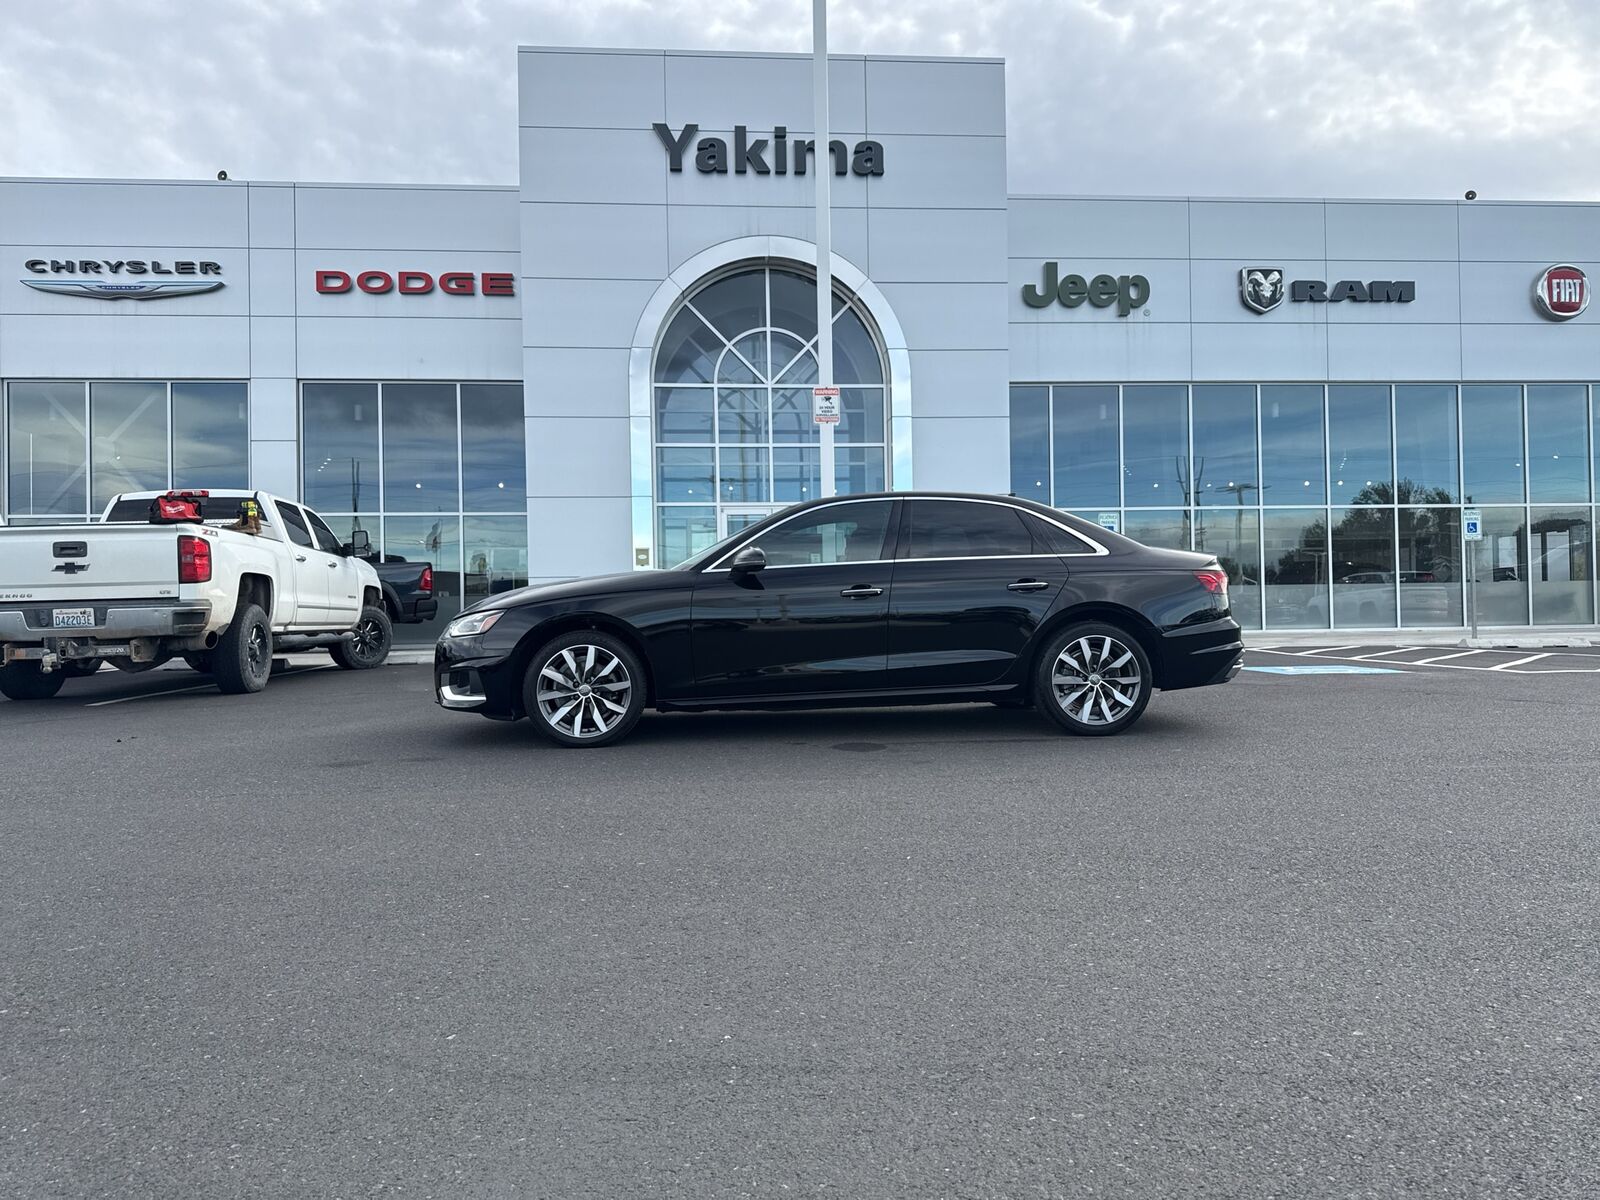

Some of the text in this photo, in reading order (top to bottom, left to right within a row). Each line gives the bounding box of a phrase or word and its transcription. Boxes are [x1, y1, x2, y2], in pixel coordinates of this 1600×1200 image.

[652, 122, 884, 176] Yakima
[24, 259, 223, 275] CHRYSLER
[315, 270, 515, 296] DODGE
[1022, 261, 1151, 317] Jeep
[1290, 280, 1416, 304] RAM
[1551, 278, 1582, 303] FIAT
